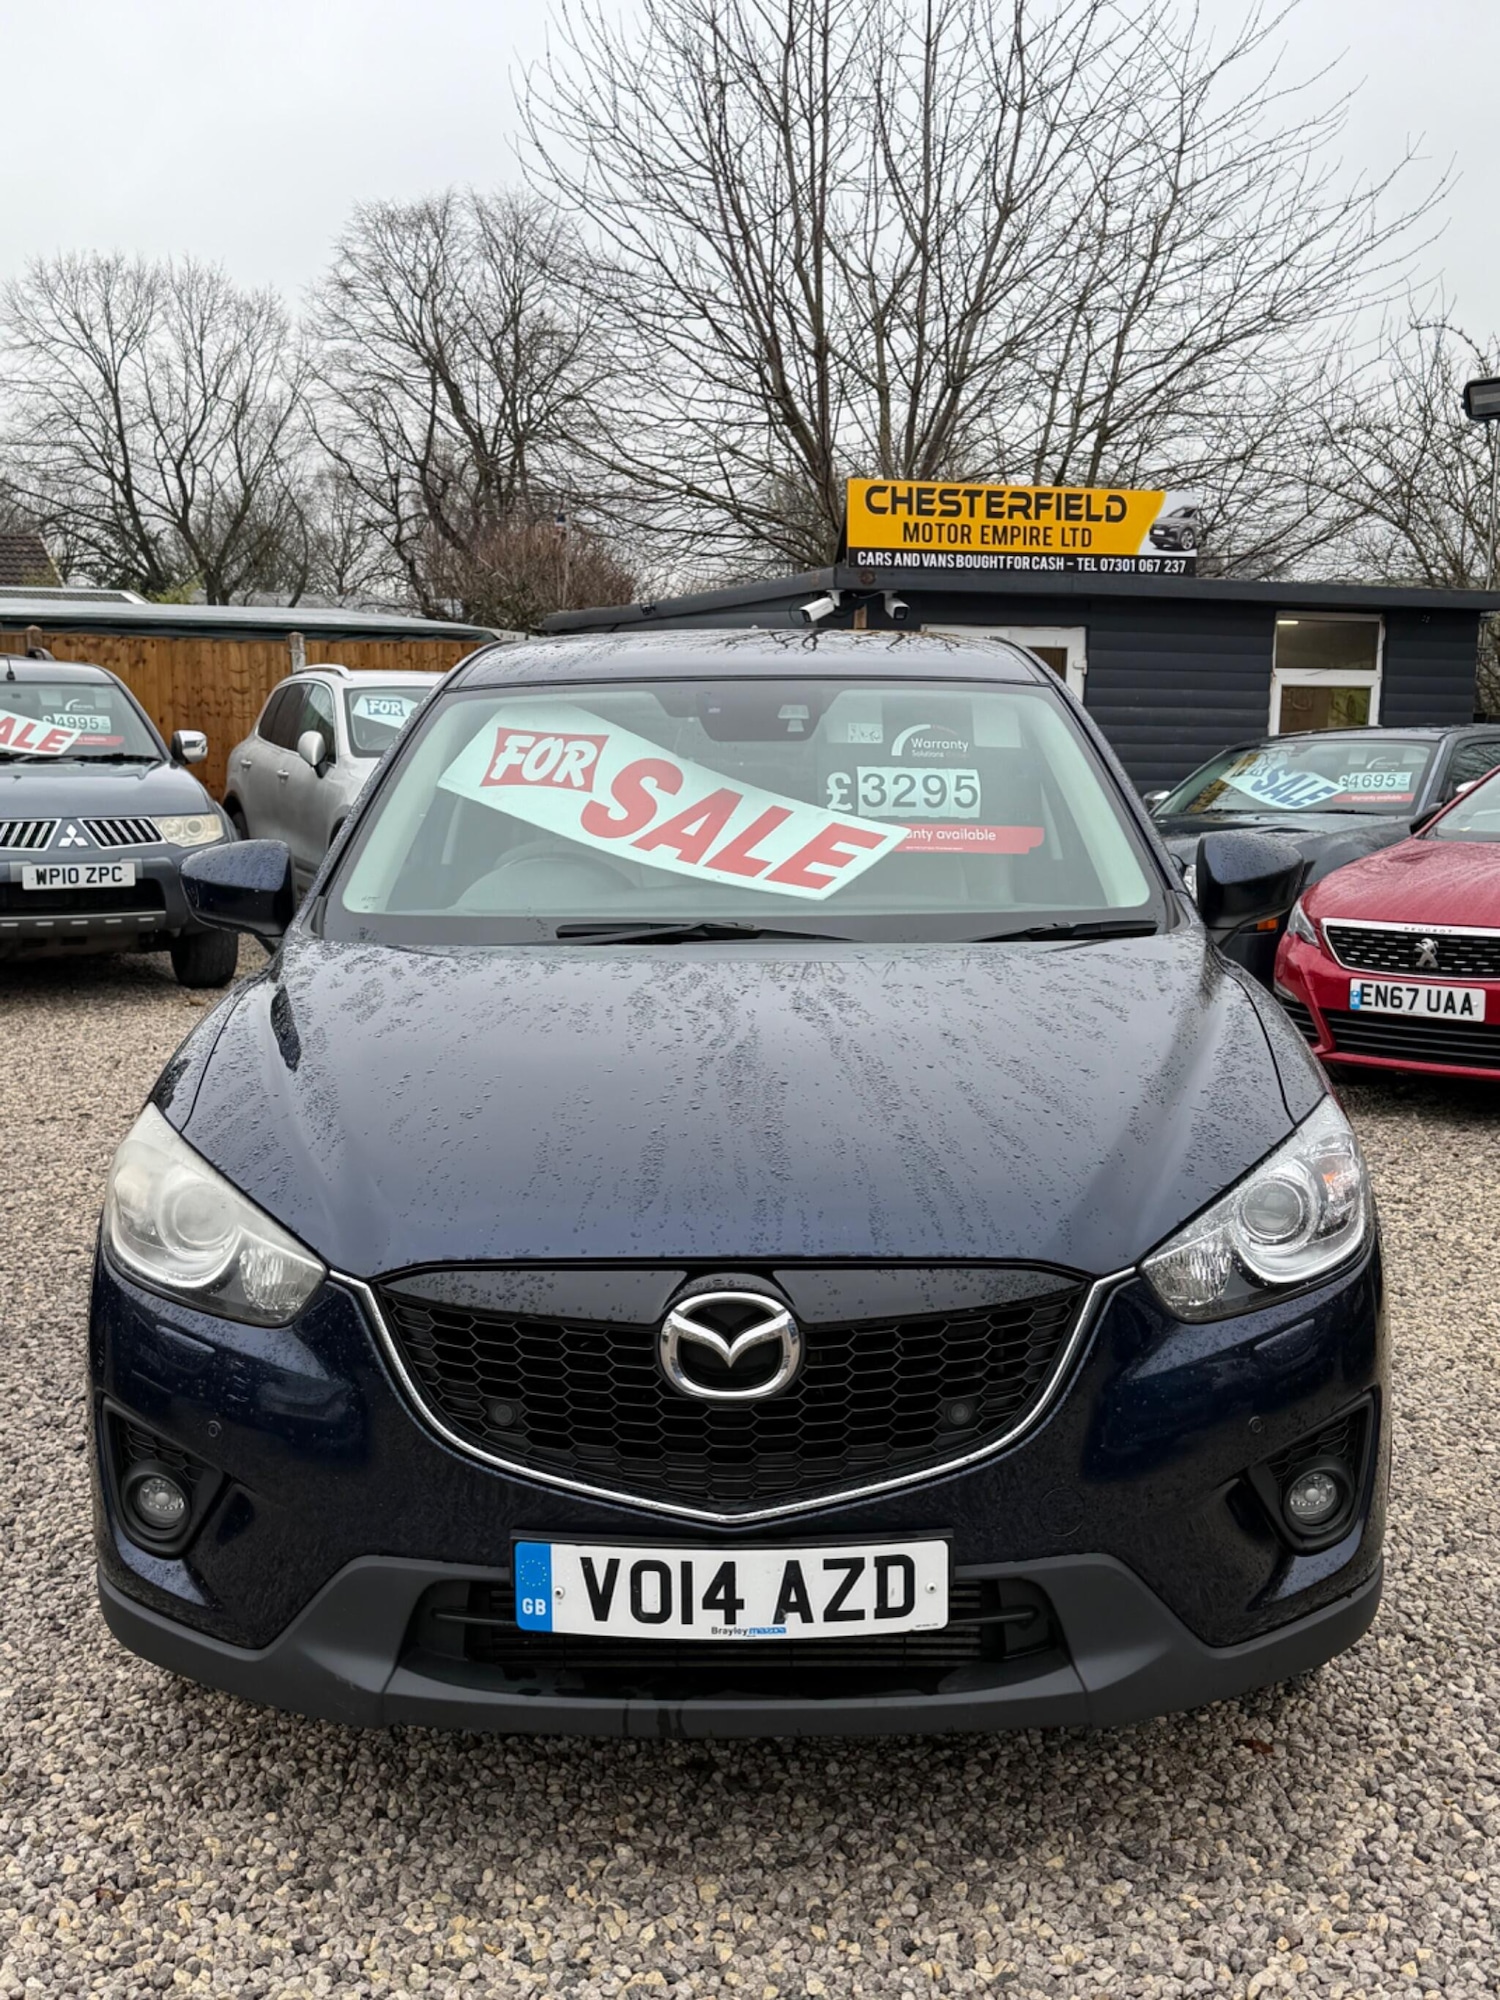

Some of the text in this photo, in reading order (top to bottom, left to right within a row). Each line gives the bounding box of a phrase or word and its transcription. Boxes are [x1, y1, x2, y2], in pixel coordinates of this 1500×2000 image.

[865, 485, 1128, 522] CHESTERFIELD
[903, 522, 1092, 547] MOTOR EMPIRE LTD
[857, 551, 892, 567] CARS
[894, 552, 920, 567] AND
[922, 553, 955, 568] VANS
[956, 554, 1005, 569] BOUGHT
[1006, 555, 1030, 570] FOR
[1032, 556, 1064, 571] CASH
[1077, 557, 1098, 571] TEL
[1100, 558, 1136, 572] 07301
[1138, 559, 1160, 573] 067
[1164, 559, 1186, 573] 237
[368, 700, 402, 716] FOR
[911, 737, 969, 752] Warranty
[826, 772, 979, 810] £3295
[1251, 765, 1338, 807] SALE
[490, 735, 888, 890] FOR SALE
[936, 828, 996, 841] available
[36, 866, 123, 885] WP10 ZPC
[1360, 983, 1419, 1010] EN67
[1427, 989, 1474, 1015] UAA
[580, 1554, 915, 1625] VO14 AZD
[522, 1597, 547, 1615] GB
[711, 1627, 748, 1636] Brayley
